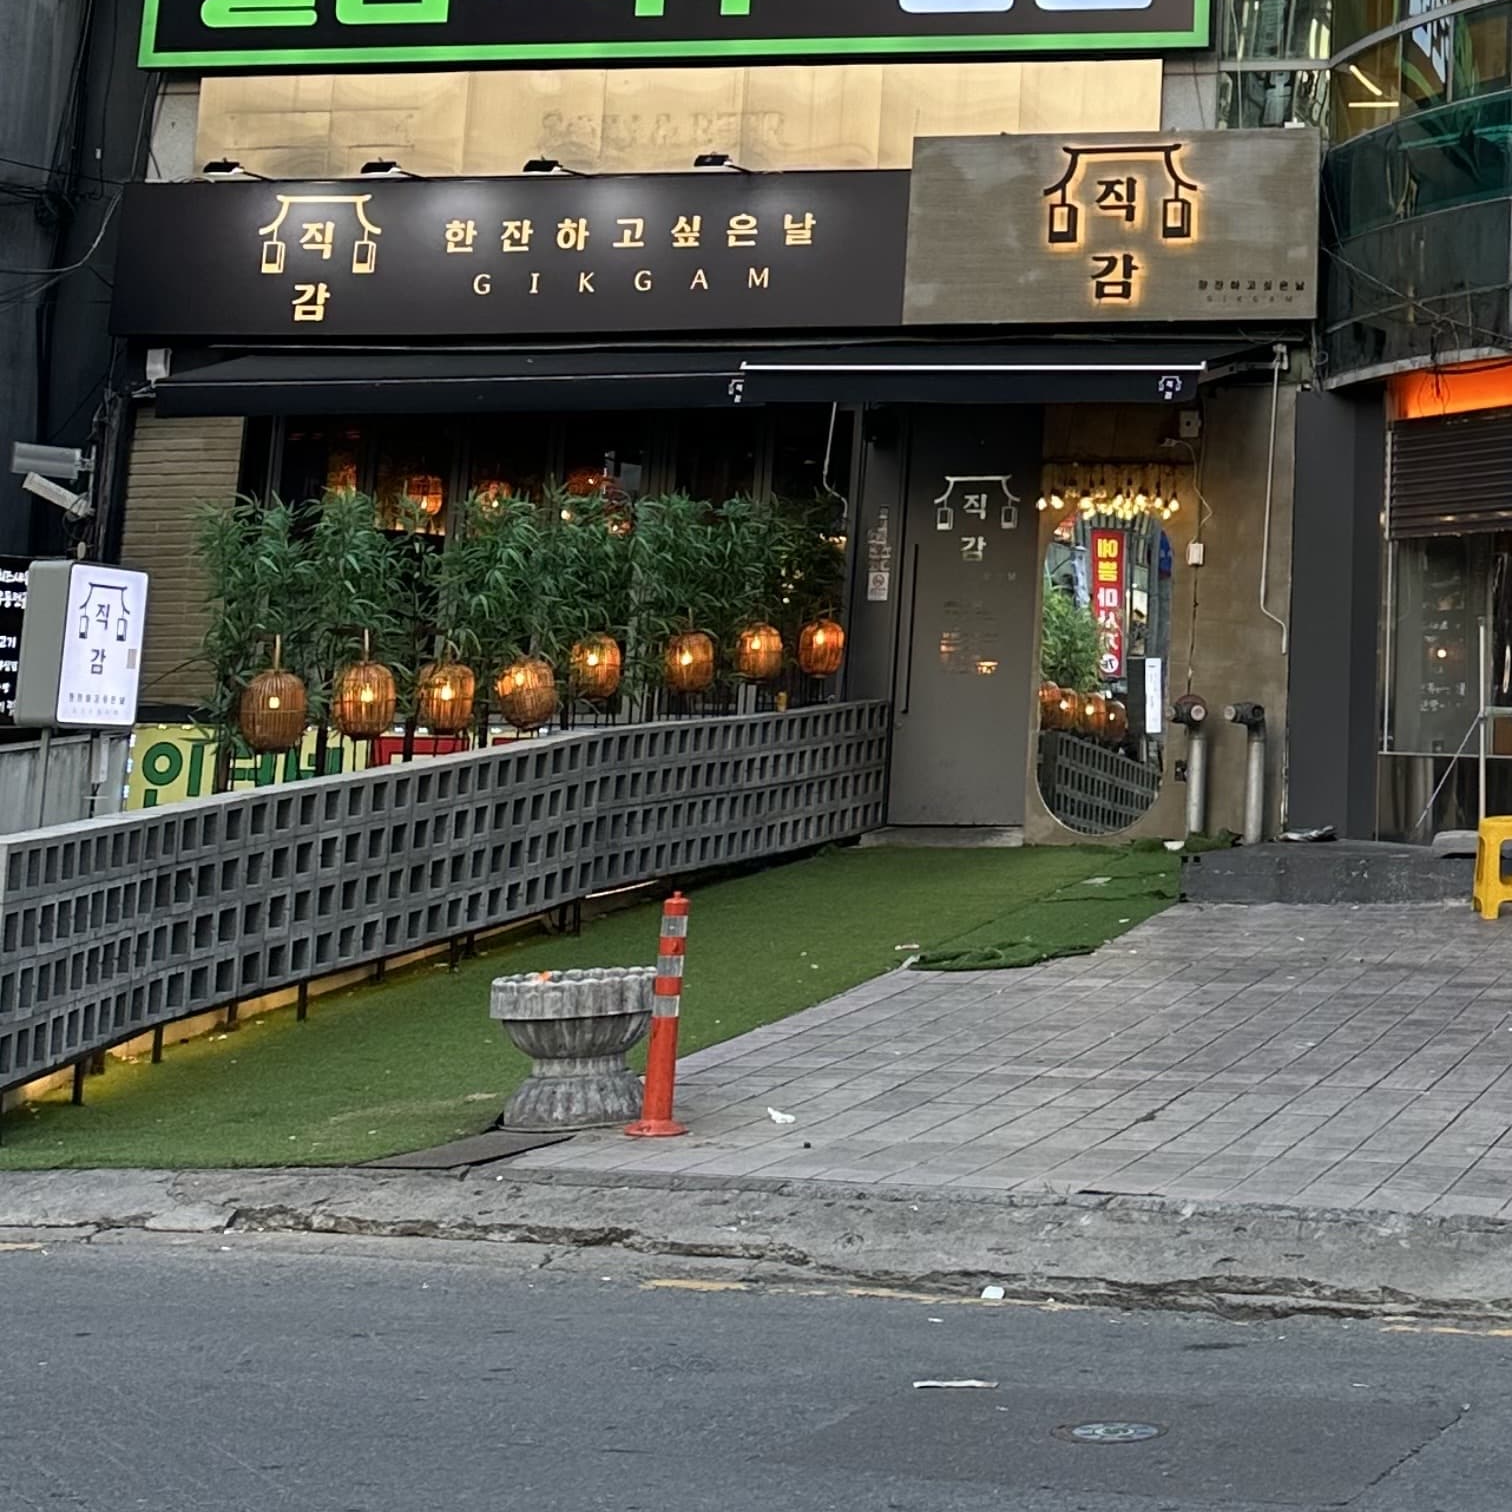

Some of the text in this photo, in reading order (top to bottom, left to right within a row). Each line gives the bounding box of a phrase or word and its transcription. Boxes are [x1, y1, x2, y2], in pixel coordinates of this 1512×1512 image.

[290, 219, 337, 323] 직감
[1089, 176, 1139, 300] 직감
[472, 266, 771, 296] GIKGAM
[960, 493, 988, 561] 직감
[90, 603, 111, 675] 직감
